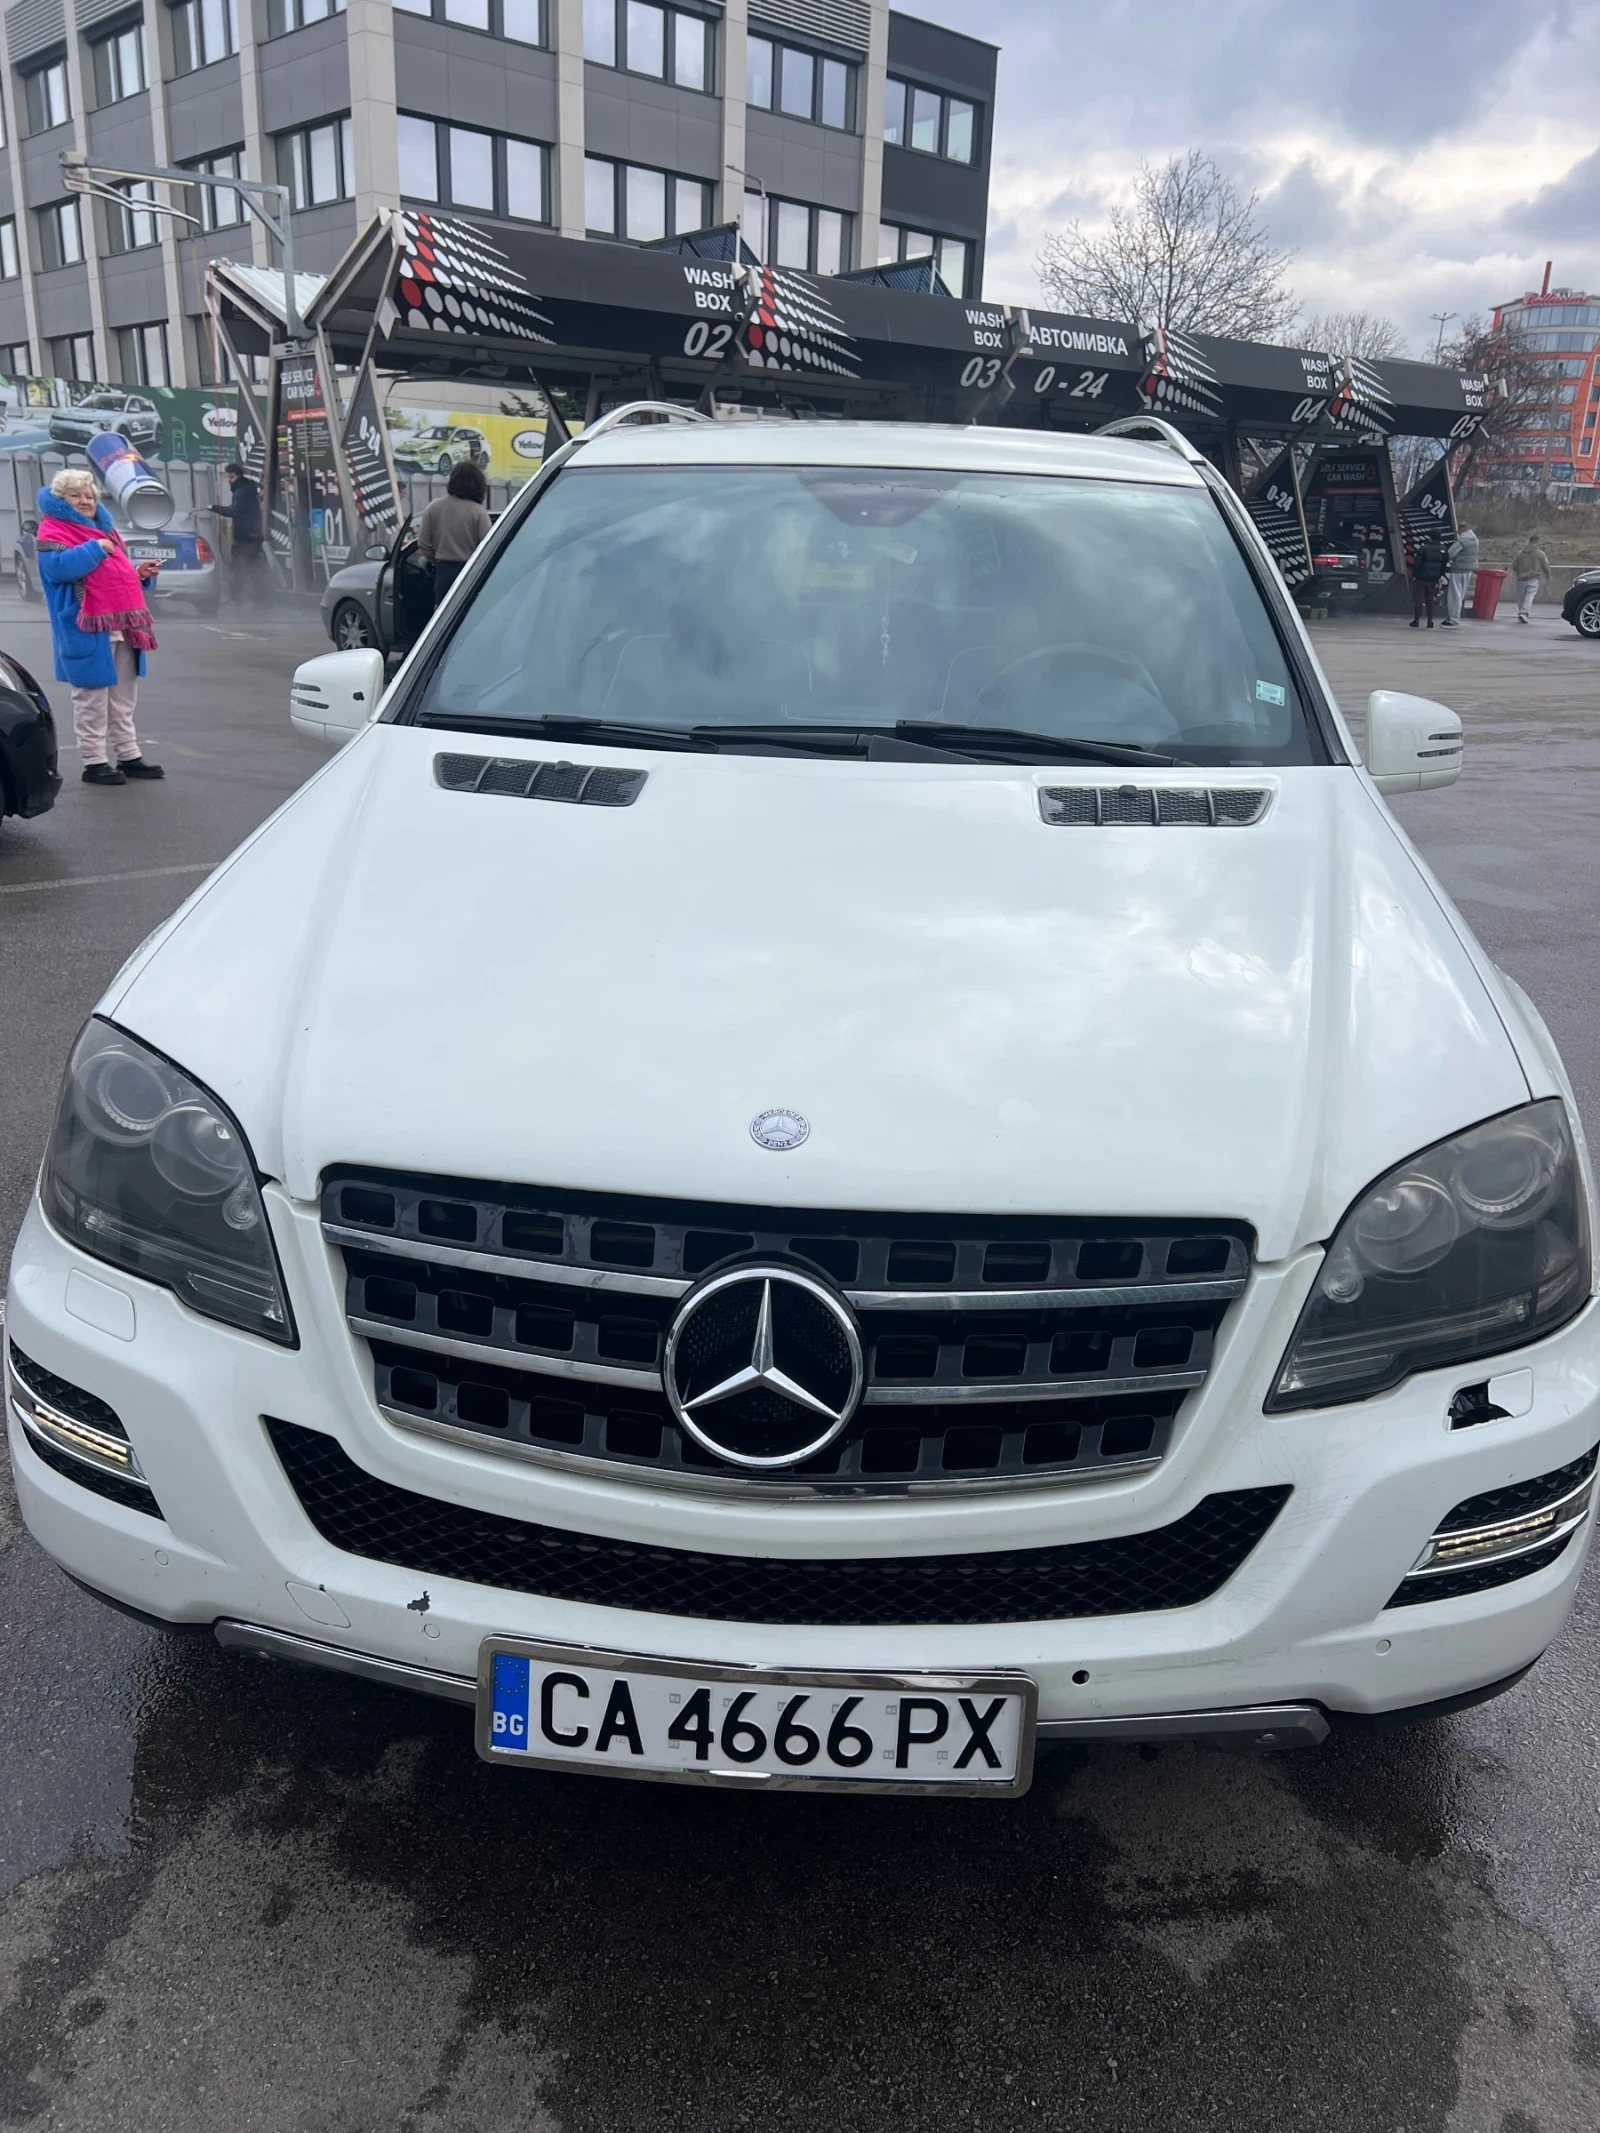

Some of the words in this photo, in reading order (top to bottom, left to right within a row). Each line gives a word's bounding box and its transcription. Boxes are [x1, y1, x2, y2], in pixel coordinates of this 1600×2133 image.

[683, 266, 735, 290] WASH
[694, 291, 732, 312] BOX
[965, 309, 1006, 329] WASH
[683, 321, 733, 358] 02
[974, 331, 1003, 348] BOX
[1029, 325, 1129, 356] АВТОМИВКА
[960, 357, 1002, 389] 03
[1300, 357, 1330, 374] WASH
[1307, 375, 1328, 390] BOX
[1460, 379, 1485, 393] WASH
[1291, 397, 1327, 423] 04
[1465, 394, 1484, 408] BOX
[1450, 414, 1483, 438] 05
[518, 439, 545, 450] Yellow
[1337, 463, 1366, 472] SERVICE
[1343, 472, 1365, 481] WASH
[1266, 485, 1294, 512] 0-24
[1421, 494, 1449, 519] 0-24
[324, 508, 344, 546] 01
[493, 1711, 524, 1736] BG
[541, 1671, 645, 1755] CA
[668, 1687, 874, 1768] 4666
[896, 1697, 1008, 1769] PX
